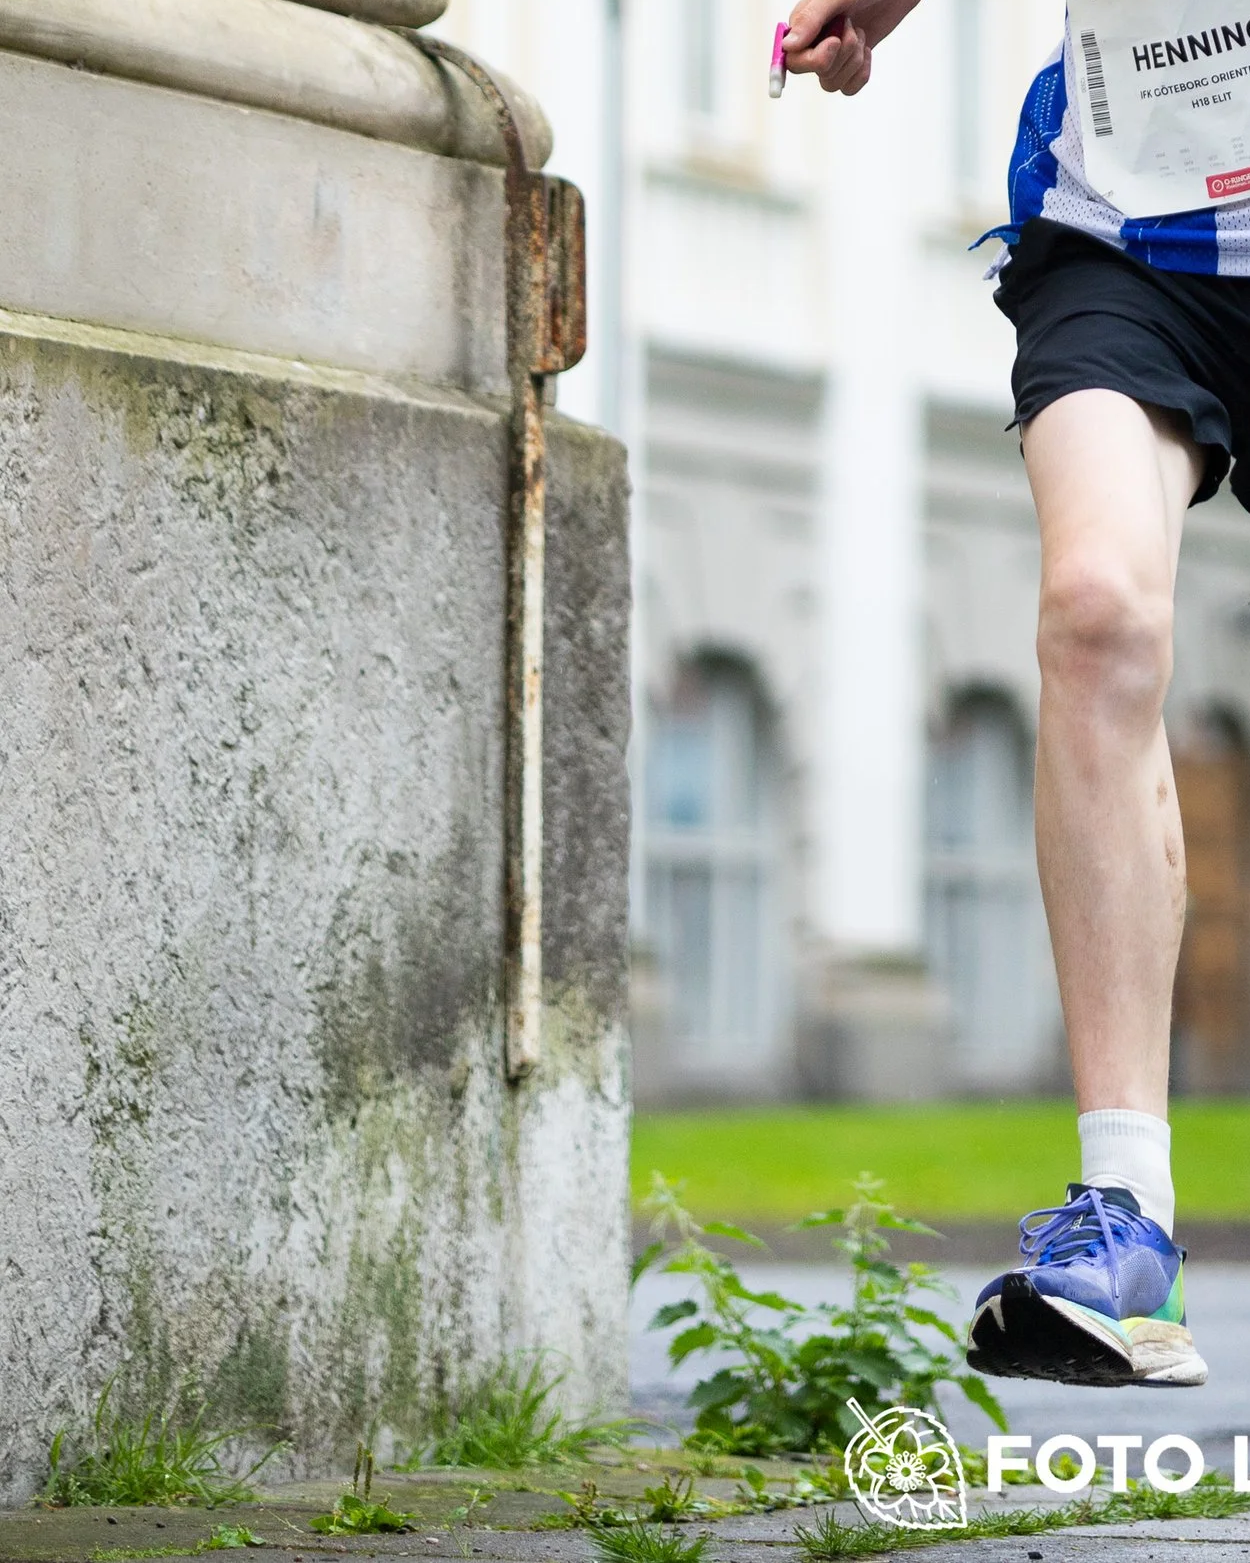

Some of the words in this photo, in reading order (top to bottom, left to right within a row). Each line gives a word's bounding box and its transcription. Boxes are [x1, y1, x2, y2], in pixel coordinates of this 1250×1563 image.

[1139, 88, 1154, 100] IFK
[1153, 77, 1210, 98] GÖTEBORG
[1191, 96, 1211, 109] H18
[1212, 91, 1233, 104] ELIT
